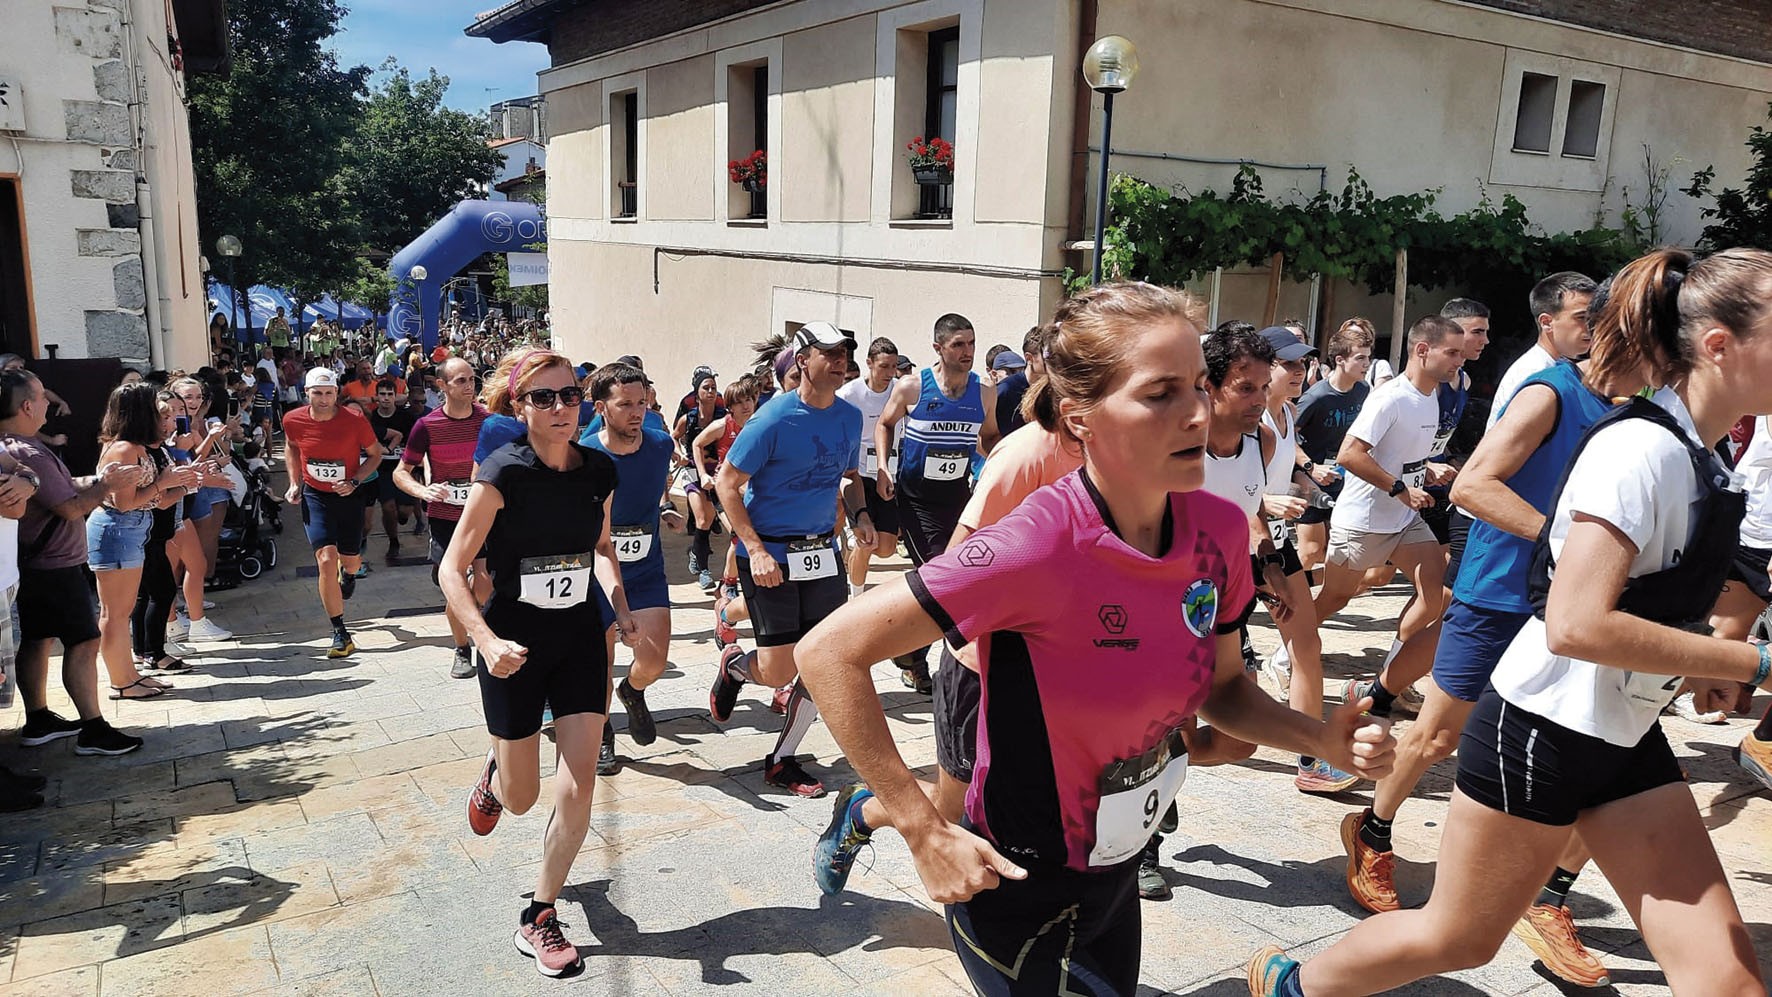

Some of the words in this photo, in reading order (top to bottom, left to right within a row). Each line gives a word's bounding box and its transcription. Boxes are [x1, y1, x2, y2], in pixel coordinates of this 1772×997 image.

[930, 422, 972, 433] ANDUTZ
[315, 468, 337, 478] 132
[939, 462, 957, 475] 49
[612, 539, 641, 554] 149
[803, 554, 821, 571] 99
[545, 576, 573, 599] 12
[1143, 788, 1159, 829] 9
